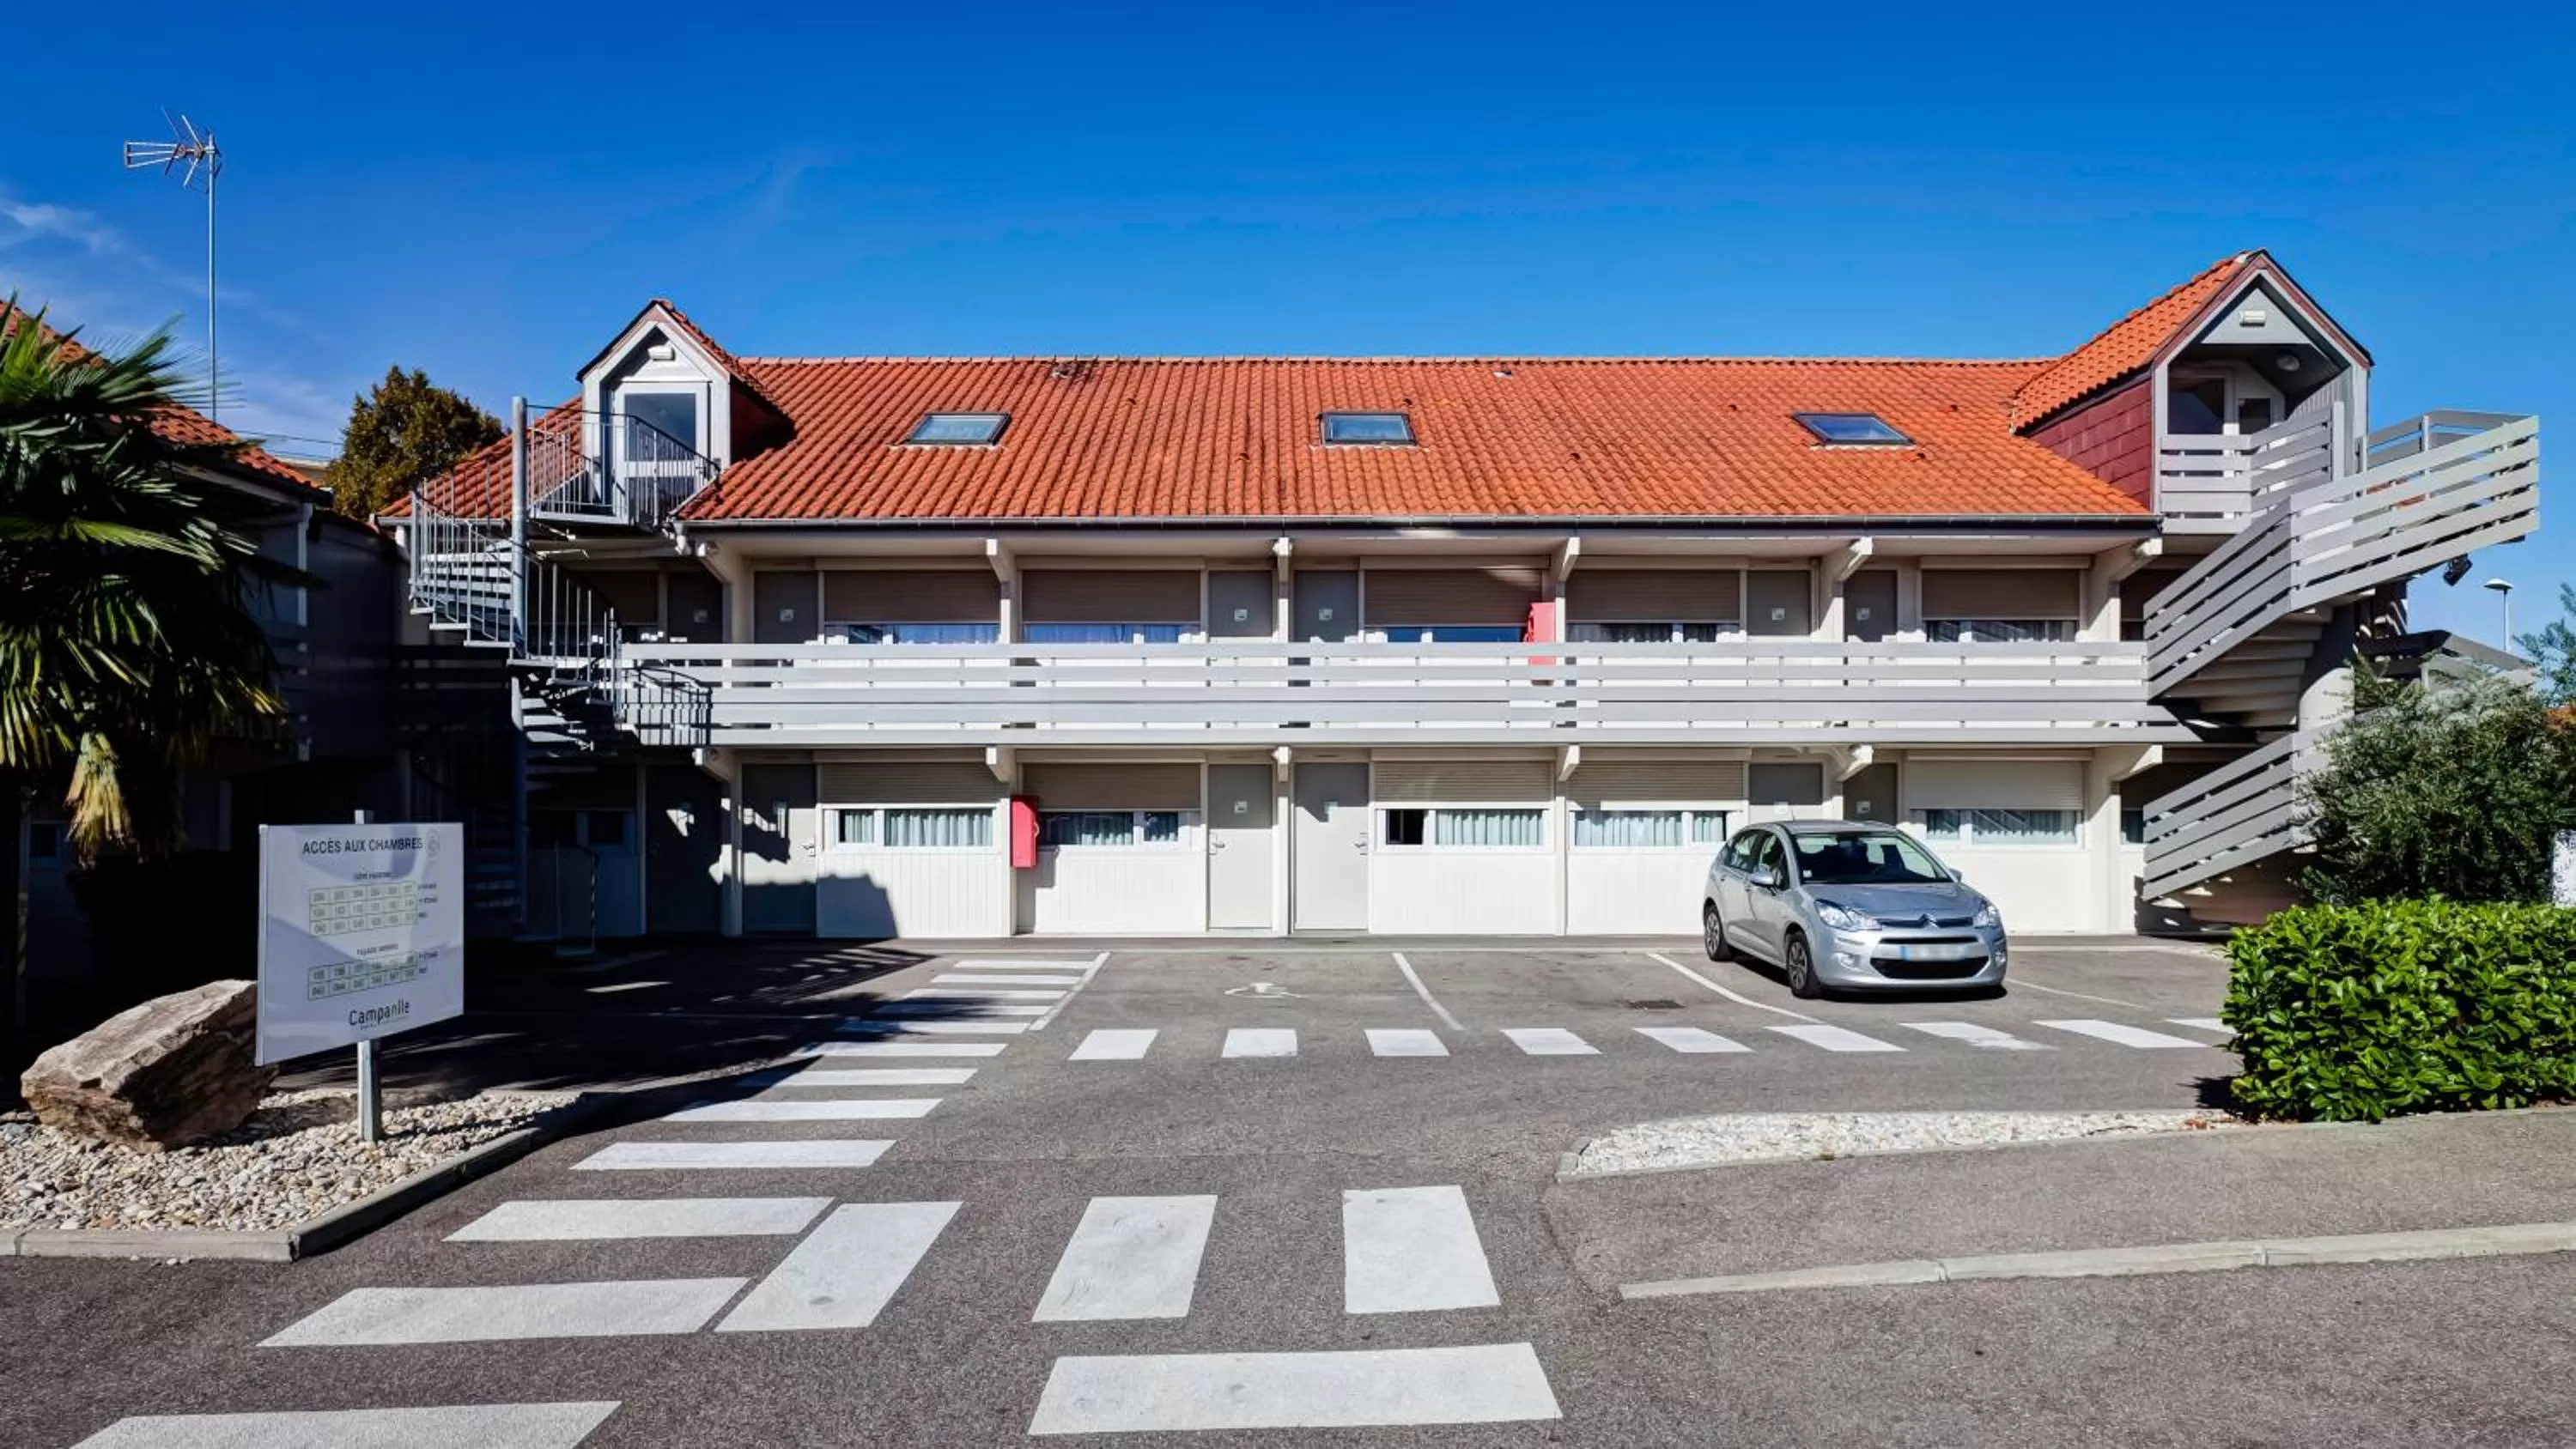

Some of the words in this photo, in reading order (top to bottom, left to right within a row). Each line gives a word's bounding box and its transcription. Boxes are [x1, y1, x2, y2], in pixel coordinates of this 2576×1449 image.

[344, 838, 367, 852] AUX
[368, 837, 423, 852] CHAMBRES
[349, 998, 410, 1026] Campanile
